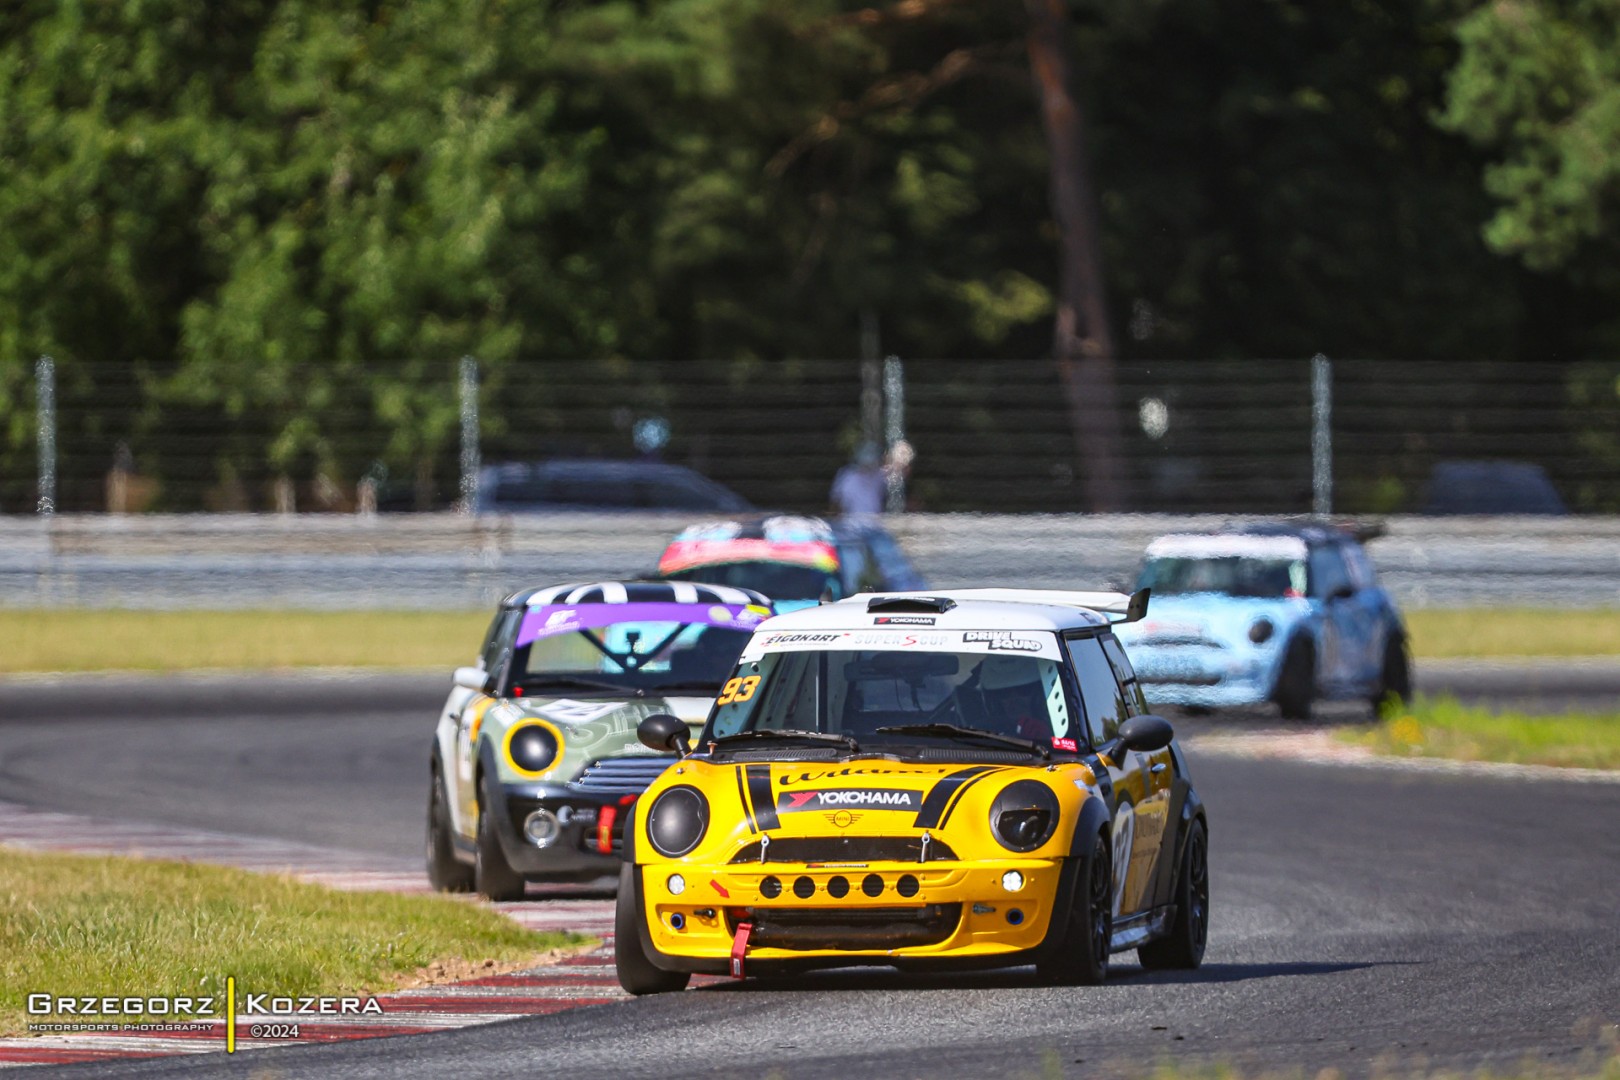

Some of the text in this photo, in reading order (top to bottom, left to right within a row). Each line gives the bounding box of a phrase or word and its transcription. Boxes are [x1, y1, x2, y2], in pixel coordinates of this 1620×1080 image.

[890, 617, 933, 625] YOKOHAMA
[854, 634, 900, 645] SUPER
[964, 631, 1013, 642] DRIVE
[990, 639, 1043, 652] SQUAD
[717, 675, 762, 706] 93
[817, 791, 911, 806] YOKOHAMA
[835, 815, 851, 823] MINI
